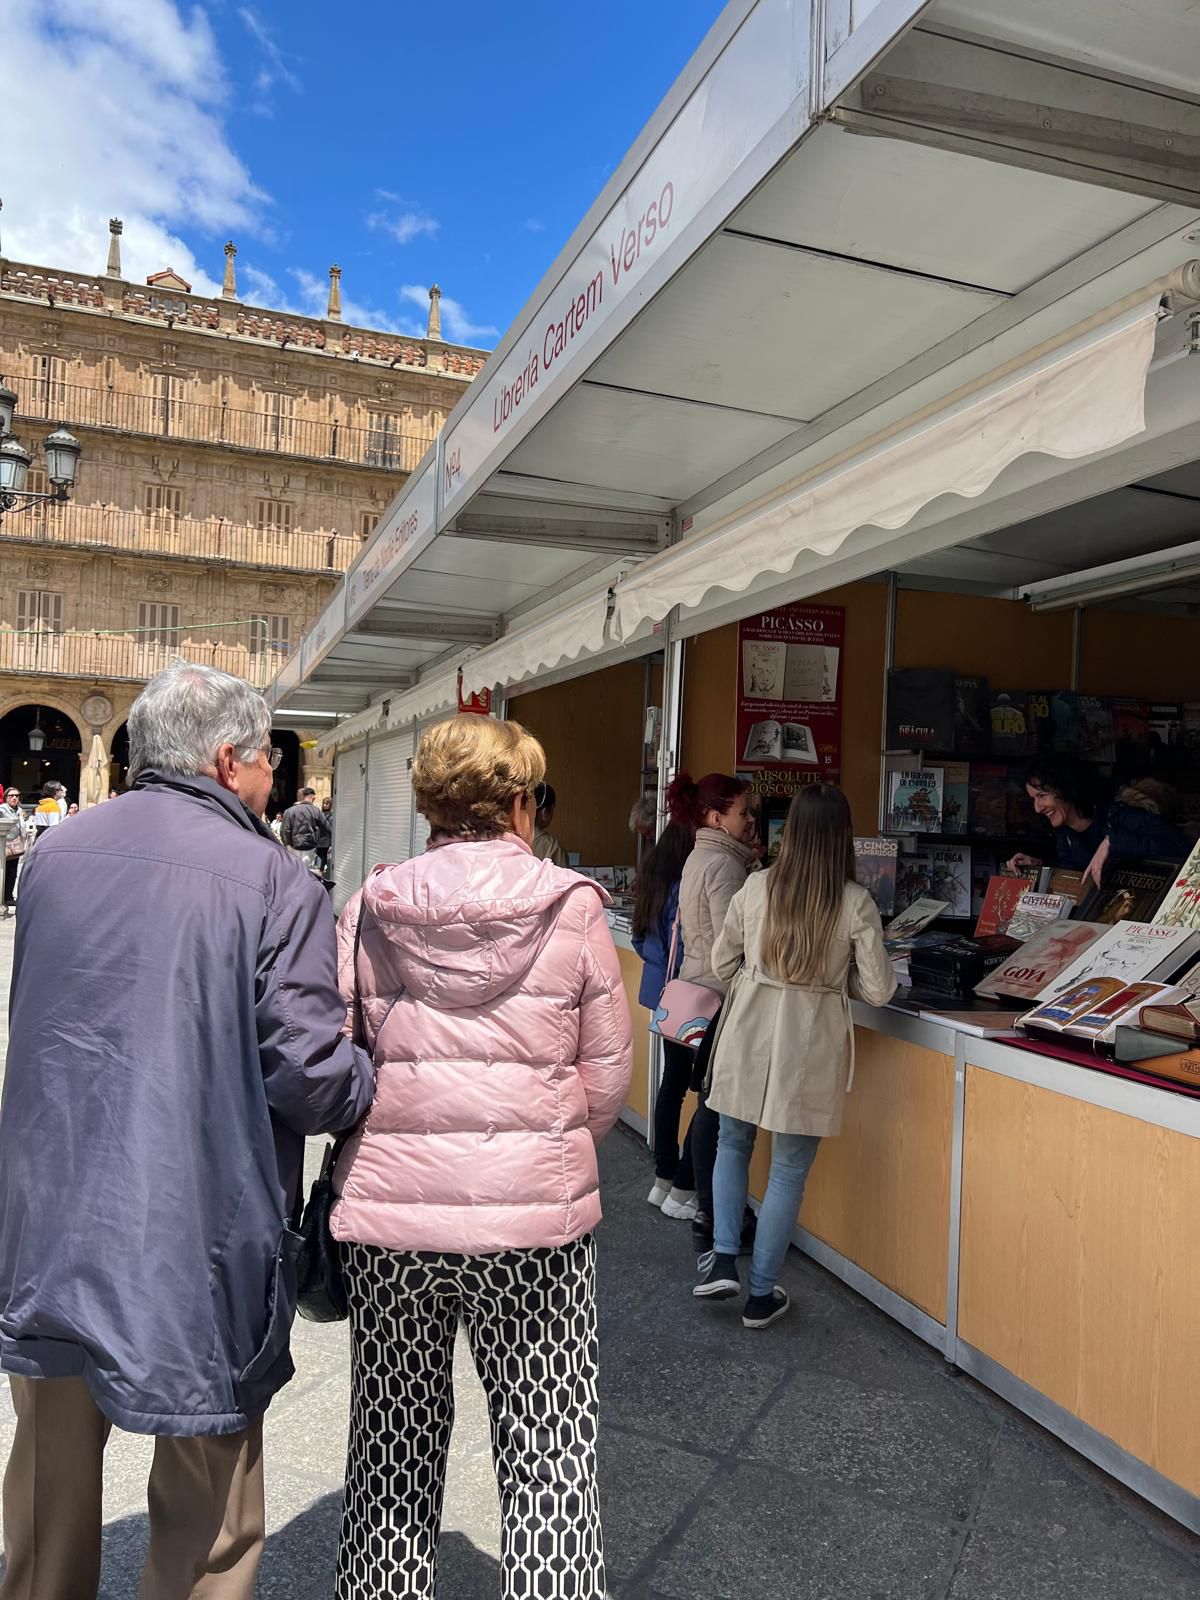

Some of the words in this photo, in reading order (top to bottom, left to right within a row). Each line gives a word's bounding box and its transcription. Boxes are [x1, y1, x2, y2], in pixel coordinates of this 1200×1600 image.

[493, 349, 539, 432] Librería
[543, 270, 603, 370] Cartem
[611, 182, 673, 285] Verso
[761, 615, 825, 632] PICASSO
[899, 725, 936, 737] DRÁCULA
[756, 770, 822, 784] ABSOLUTE
[864, 841, 898, 852] CINCO
[1111, 872, 1165, 892] DURERO
[1125, 925, 1178, 938] PICASSO
[1003, 965, 1047, 983] GOYA
